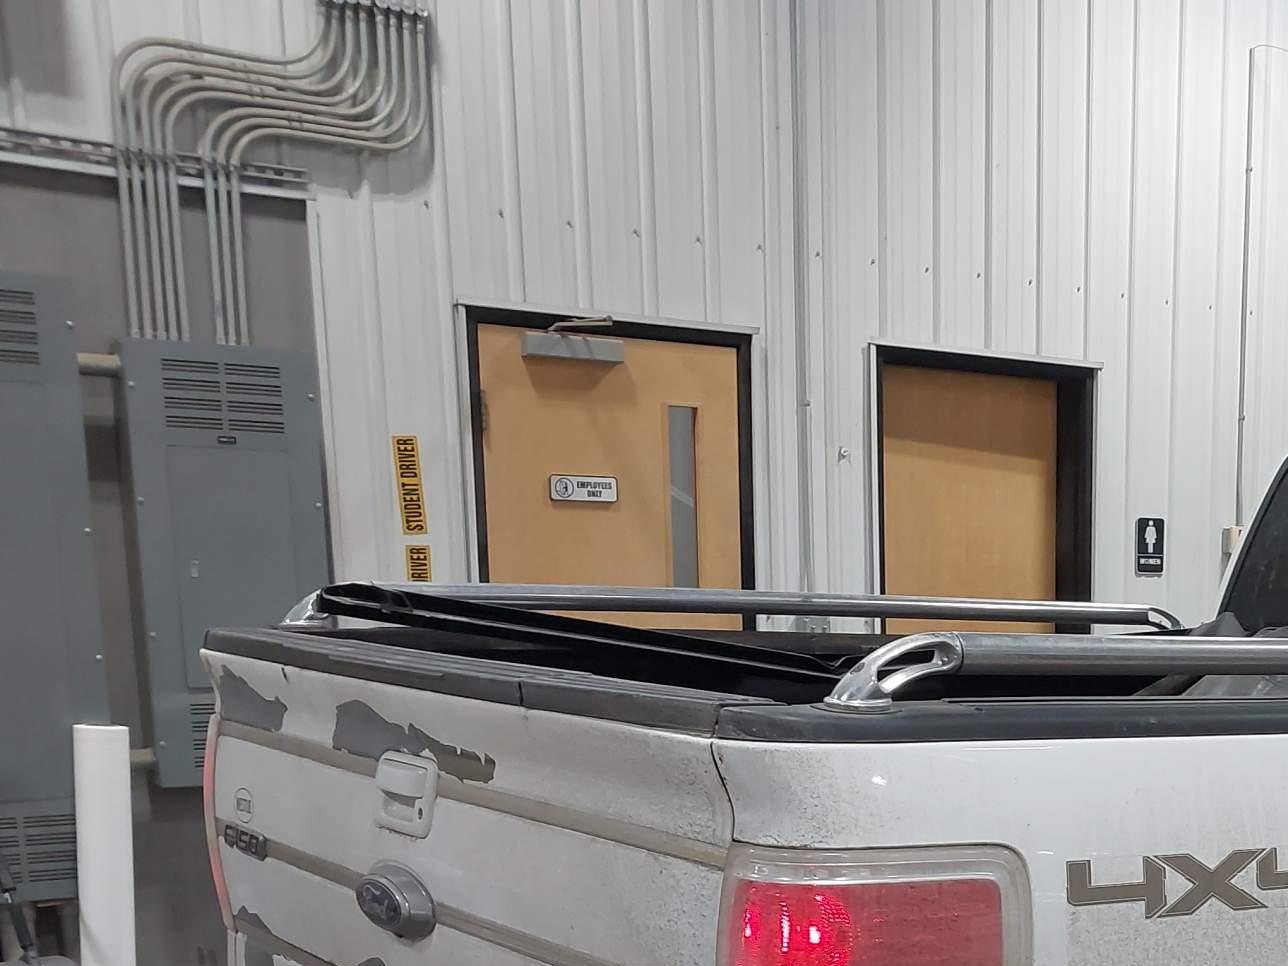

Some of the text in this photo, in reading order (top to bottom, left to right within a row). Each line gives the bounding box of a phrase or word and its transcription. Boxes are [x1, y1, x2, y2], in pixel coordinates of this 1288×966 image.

[396, 438, 424, 531] STUDENT DRIVER
[576, 480, 612, 490] EMPLOYEES
